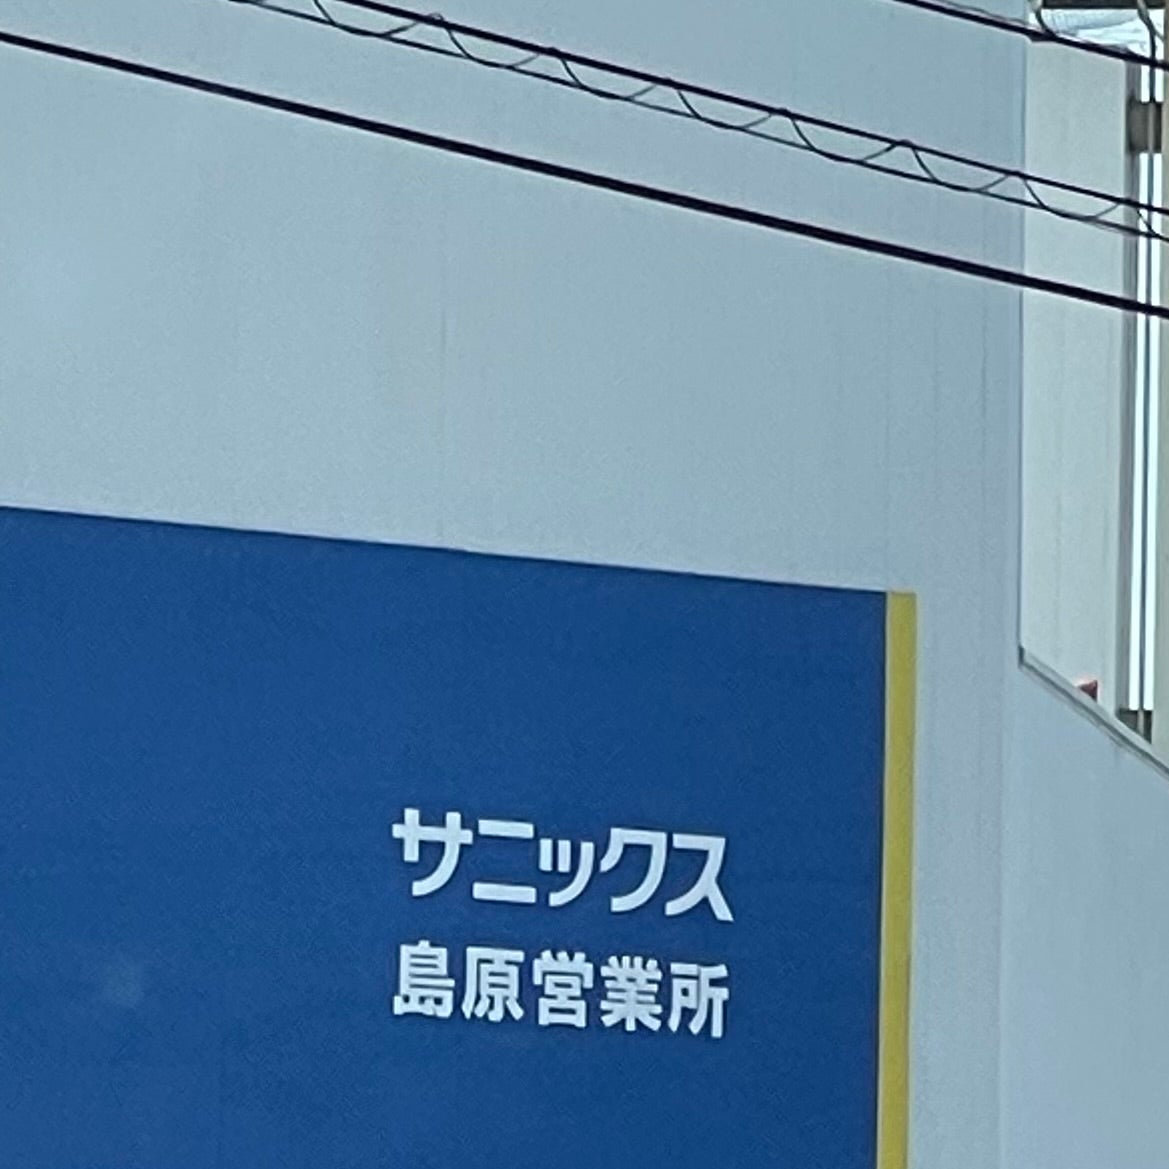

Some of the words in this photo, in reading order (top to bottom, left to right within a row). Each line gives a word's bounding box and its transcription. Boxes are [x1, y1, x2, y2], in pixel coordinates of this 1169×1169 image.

[392, 808, 734, 922] サニックス
[393, 940, 730, 1038] 島原営業所
